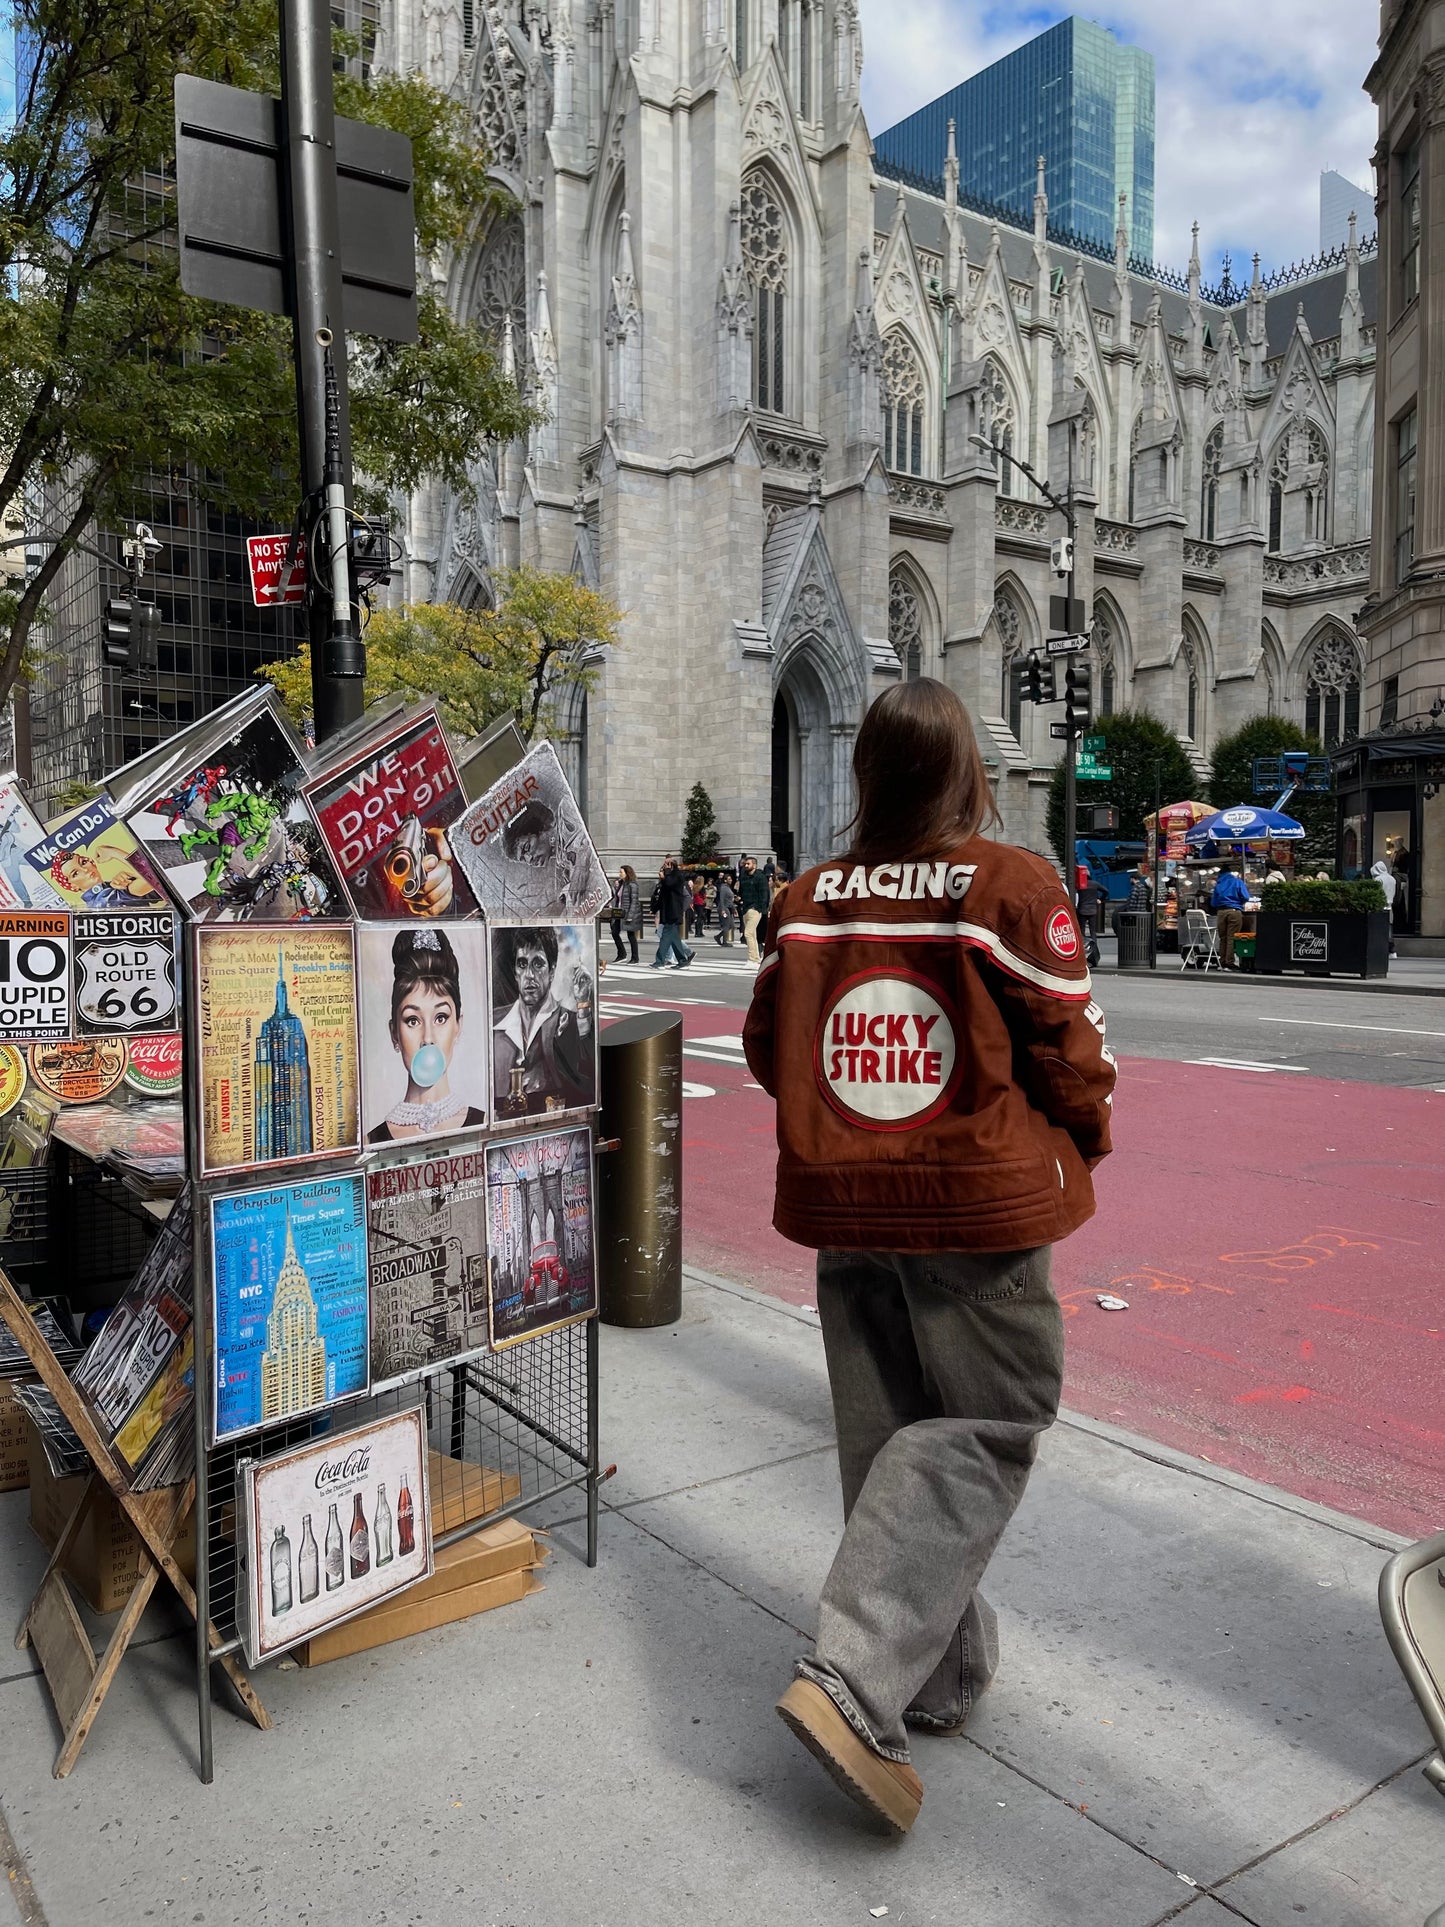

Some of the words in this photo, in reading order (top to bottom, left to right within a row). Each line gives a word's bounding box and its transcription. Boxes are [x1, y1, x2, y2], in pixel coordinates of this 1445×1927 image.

[254, 544, 271, 558] NO
[1052, 641, 1065, 650] ONE
[1070, 638, 1084, 647] WAY
[1087, 739, 1092, 749] 5
[1085, 755, 1091, 765] 50
[346, 751, 402, 798] WE
[413, 764, 454, 810] 911
[337, 757, 427, 841] DON'T
[470, 775, 540, 847] GUITAR
[31, 844, 59, 865] We
[54, 827, 86, 850] Can
[78, 814, 104, 833] Do
[813, 861, 979, 902] RACING
[74, 917, 173, 936] HISTORIC
[1052, 923, 1073, 938] LUCKY
[1293, 927, 1315, 942] Saks
[316, 943, 337, 951] York
[1055, 934, 1076, 947] STRIKE
[1293, 942, 1324, 956] Avenue
[1304, 936, 1327, 949] Fifth
[103, 951, 149, 967] OLD
[285, 951, 325, 962] Rockefeller
[95, 968, 157, 983] ROUTE
[200, 966, 237, 978] Times
[239, 965, 275, 975] Square
[293, 963, 327, 974] Brooklyn
[329, 961, 353, 973] Bridge
[299, 975, 322, 984] Lincoln
[323, 974, 343, 983] Center
[97, 986, 158, 1018] 66
[211, 990, 274, 1001] Metropolitan
[303, 1006, 325, 1017] Grand
[326, 1004, 351, 1016] Central
[311, 1015, 344, 1026] Terminal
[9, 1030, 33, 1038] THIS
[35, 1029, 65, 1037] POINT
[310, 1029, 331, 1040] Park
[332, 1028, 345, 1038] Av
[832, 1012, 940, 1049] LUCKY
[219, 1043, 239, 1055] Hotel
[241, 1042, 250, 1060] NEW
[231, 1056, 239, 1082] Hotel
[241, 1063, 251, 1087] YORK
[829, 1049, 943, 1085] STRIKE
[49, 1077, 90, 1088] MOTORCYCLE
[220, 1079, 230, 1120] FASHION
[231, 1086, 239, 1111] Plaza
[242, 1090, 252, 1122] PUBLIC
[221, 1122, 231, 1133] AV
[315, 1087, 325, 1152] BROADWAY
[243, 1124, 253, 1162] LIBRARY
[233, 1193, 285, 1212] Chrysler
[291, 1184, 341, 1201] Building
[445, 1188, 484, 1205] flatiron
[215, 1213, 266, 1231] BROADWAY
[291, 1213, 316, 1225] Times
[319, 1207, 345, 1220] Square
[322, 1225, 341, 1237] Wall
[343, 1222, 354, 1233] St
[434, 1219, 449, 1232] ONLY
[218, 1254, 227, 1288] Statue
[372, 1249, 440, 1286] BROADWAY
[219, 1289, 228, 1300] of
[239, 1284, 263, 1299] NYC
[417, 1310, 431, 1319] ONE
[440, 1301, 455, 1312] WAY
[219, 1302, 228, 1337] Liberty
[147, 1314, 172, 1357] NO
[219, 1347, 229, 1358] The
[231, 1342, 247, 1354] Plaza
[249, 1338, 266, 1348] Hotel
[218, 1358, 226, 1389] Bronx
[327, 1361, 336, 1399] QUEENS
[315, 1445, 373, 1489] Coca-Cola
